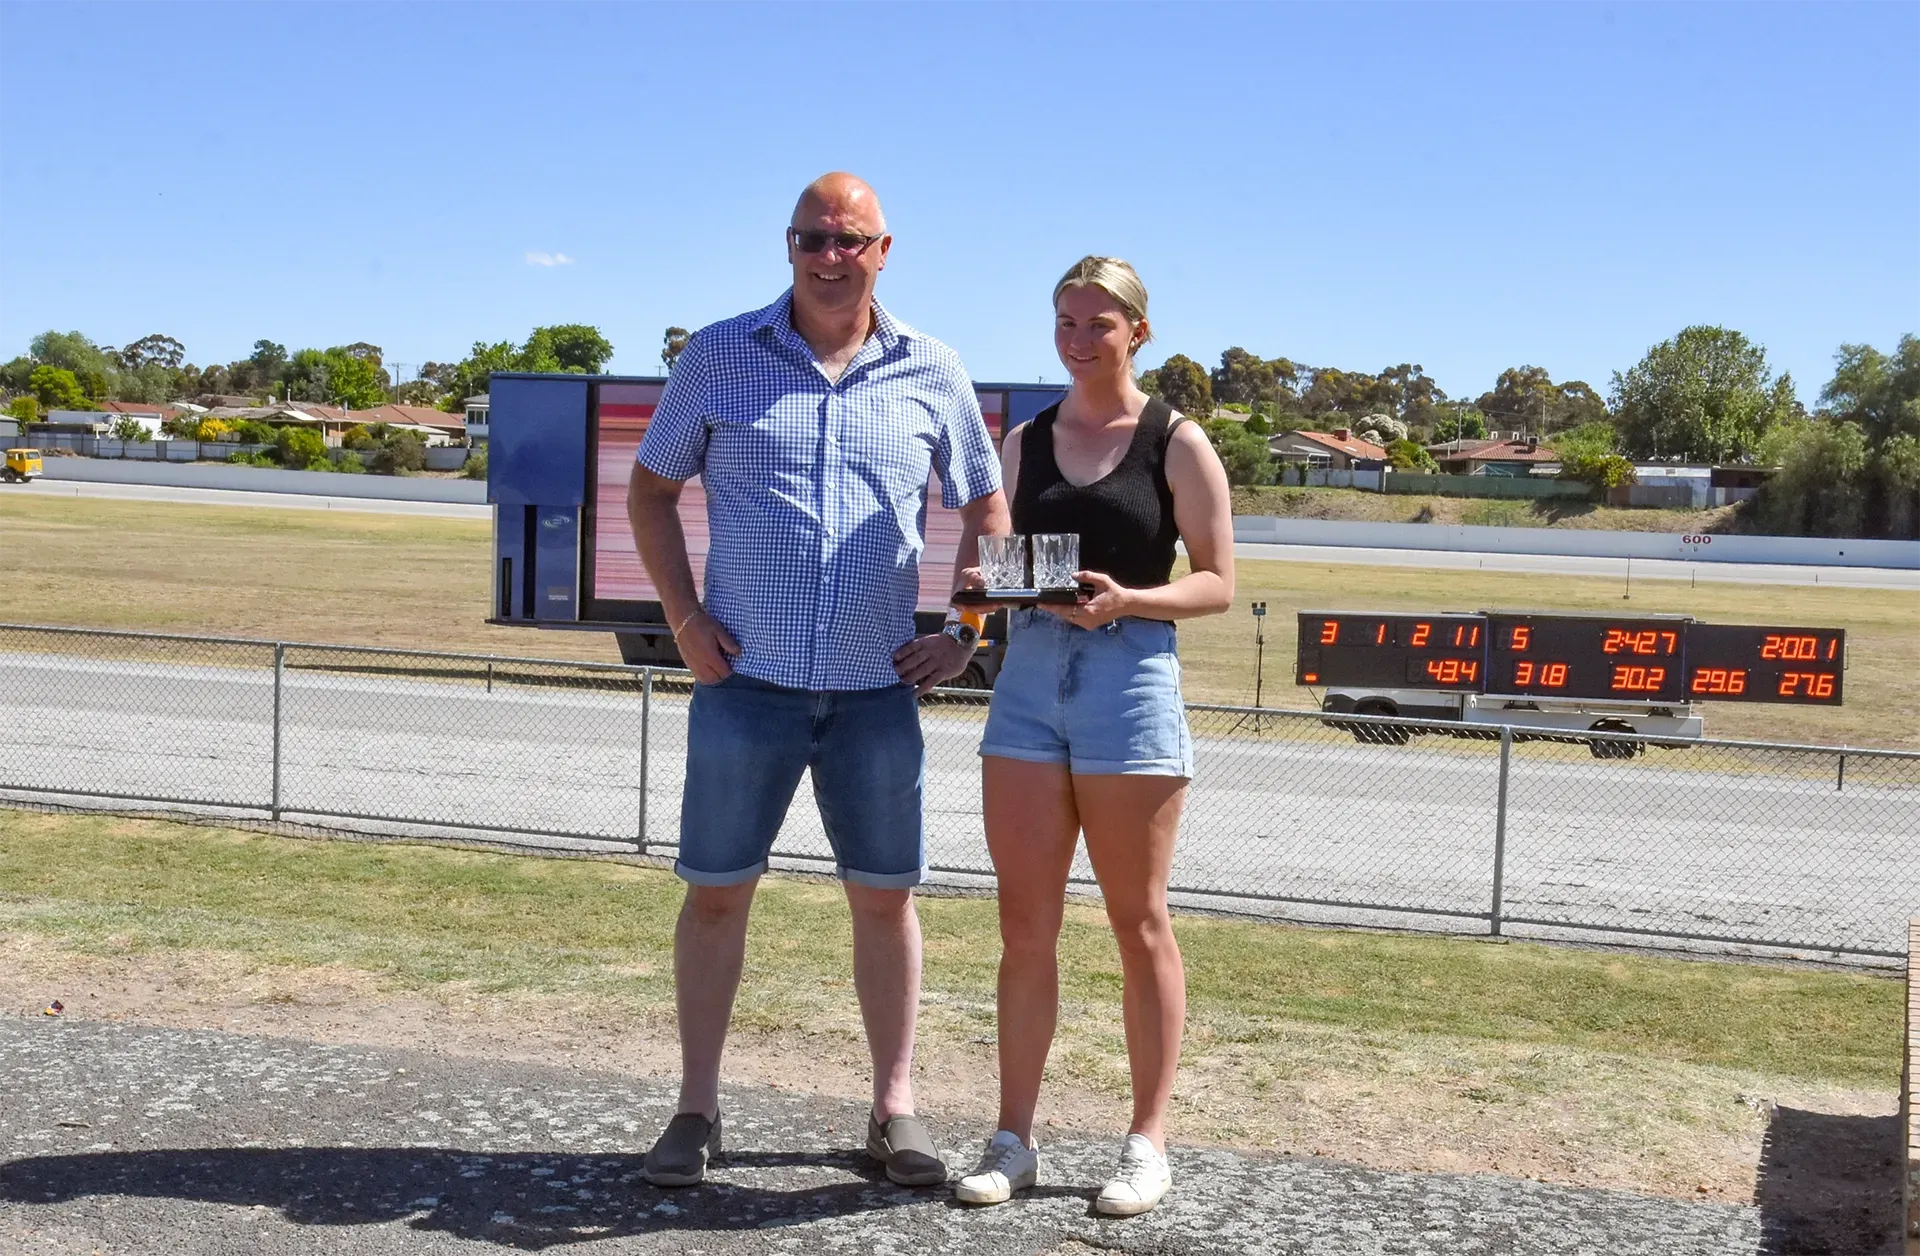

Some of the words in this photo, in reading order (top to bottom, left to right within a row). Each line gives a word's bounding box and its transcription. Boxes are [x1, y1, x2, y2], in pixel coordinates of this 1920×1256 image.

[1682, 535, 1712, 544] 600
[1320, 621, 1338, 644] 3
[1376, 624, 1386, 645] 1
[1411, 624, 1431, 646] 2
[1455, 625, 1479, 647] 11
[1511, 627, 1529, 650] 5
[1603, 630, 1676, 654] 2:42.7
[1427, 660, 1477, 683] 43.4
[1611, 666, 1665, 690] 30.2
[1692, 669, 1746, 693] 29.6
[1779, 673, 1835, 697] 27.6
